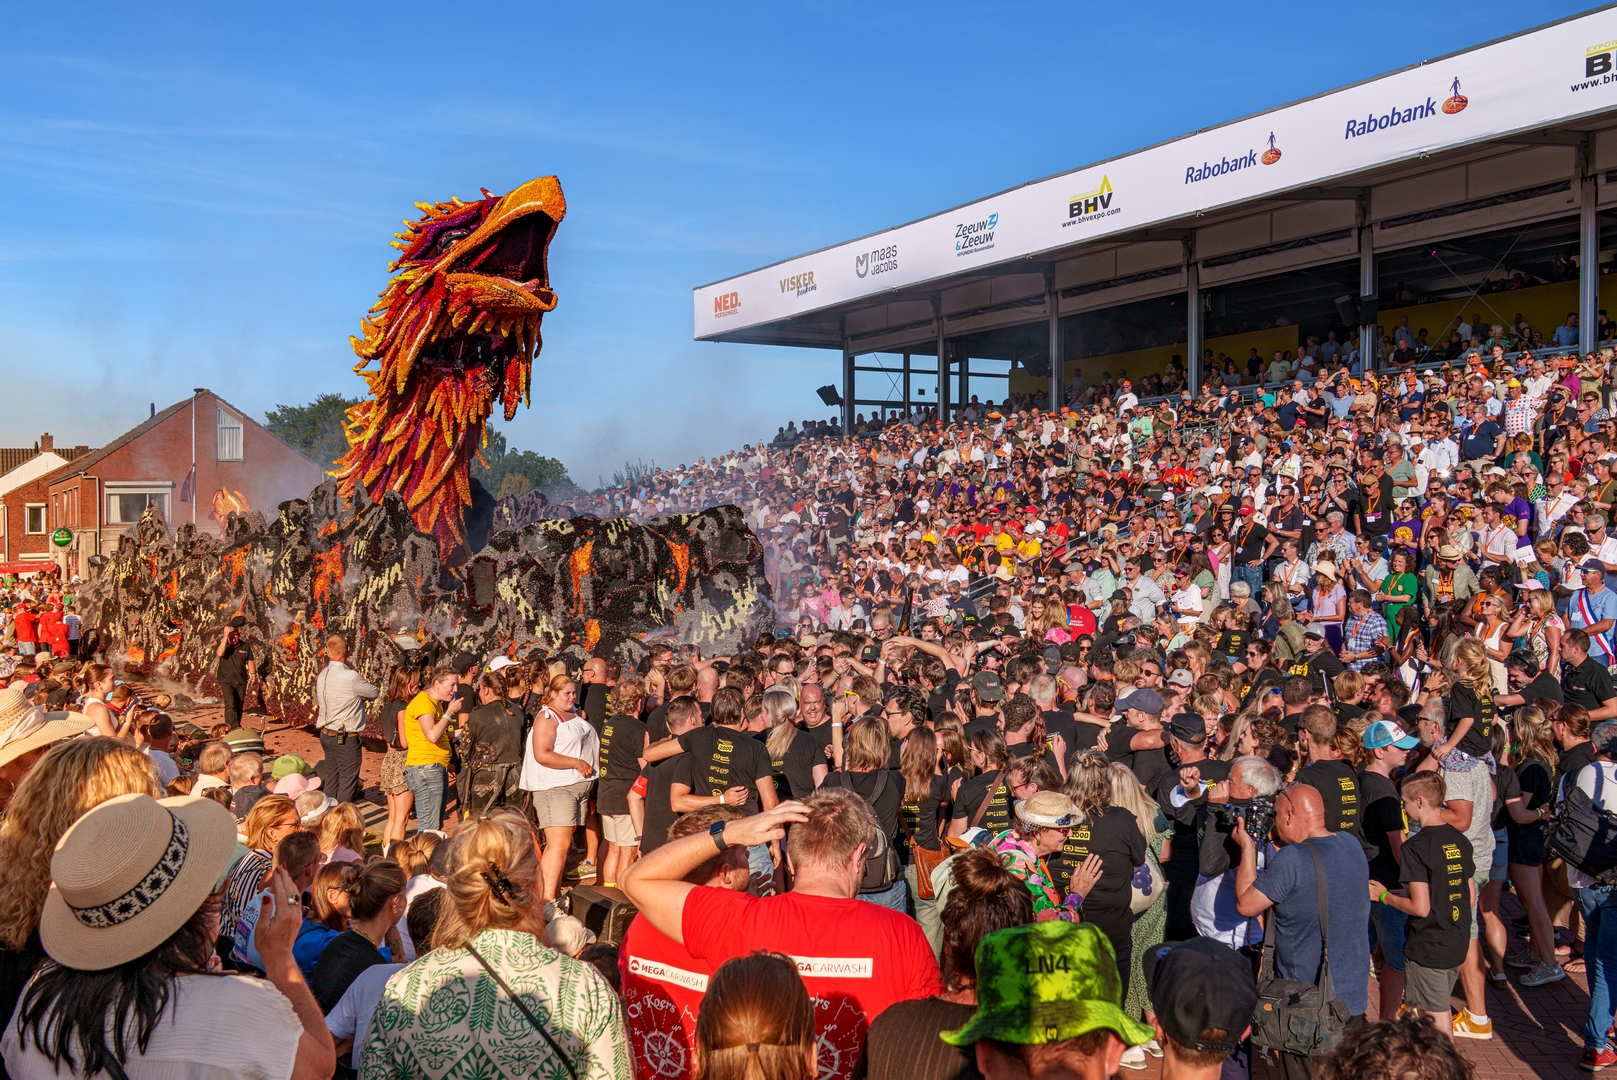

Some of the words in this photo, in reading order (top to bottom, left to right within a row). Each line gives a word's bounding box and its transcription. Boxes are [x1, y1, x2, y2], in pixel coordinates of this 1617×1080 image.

[1585, 50, 1617, 78] B
[1345, 97, 1437, 140] Rabobank
[1184, 149, 1257, 185] Rabobank
[1069, 188, 1099, 201] EXPOGROEP
[1069, 191, 1114, 218] BHV
[1062, 207, 1122, 228] www.bhvexpo.com
[955, 219, 988, 239] Zeeuw
[961, 231, 995, 250] Zeeuw
[870, 244, 898, 264] maas
[779, 271, 815, 294] VISKER
[714, 291, 742, 313] NED.
[714, 308, 739, 319] PERSONEEL
[1025, 954, 1072, 975] LN4
[641, 963, 704, 988] MEGACARWASH
